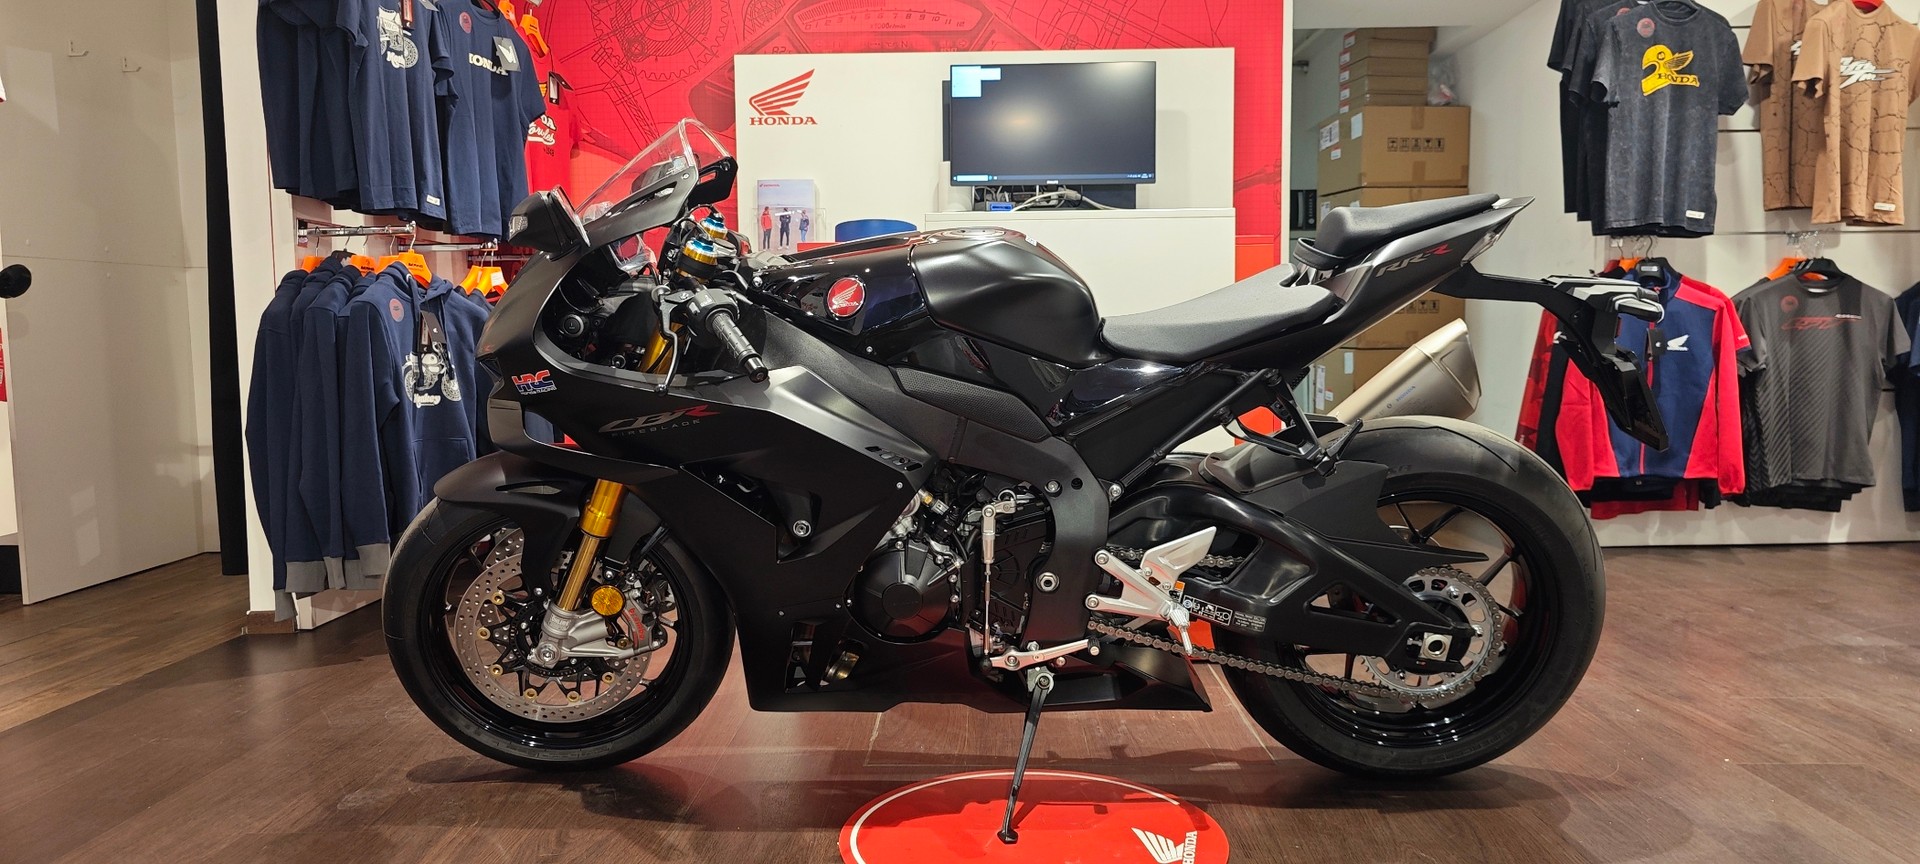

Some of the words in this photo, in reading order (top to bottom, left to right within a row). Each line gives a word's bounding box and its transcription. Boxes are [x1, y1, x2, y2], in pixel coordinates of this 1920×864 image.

[1657, 73, 1698, 85] HONDA
[749, 116, 818, 126] HONDA
[511, 369, 555, 392] HRC
[598, 404, 721, 433] CBR
[611, 418, 700, 437] FIREBLADE
